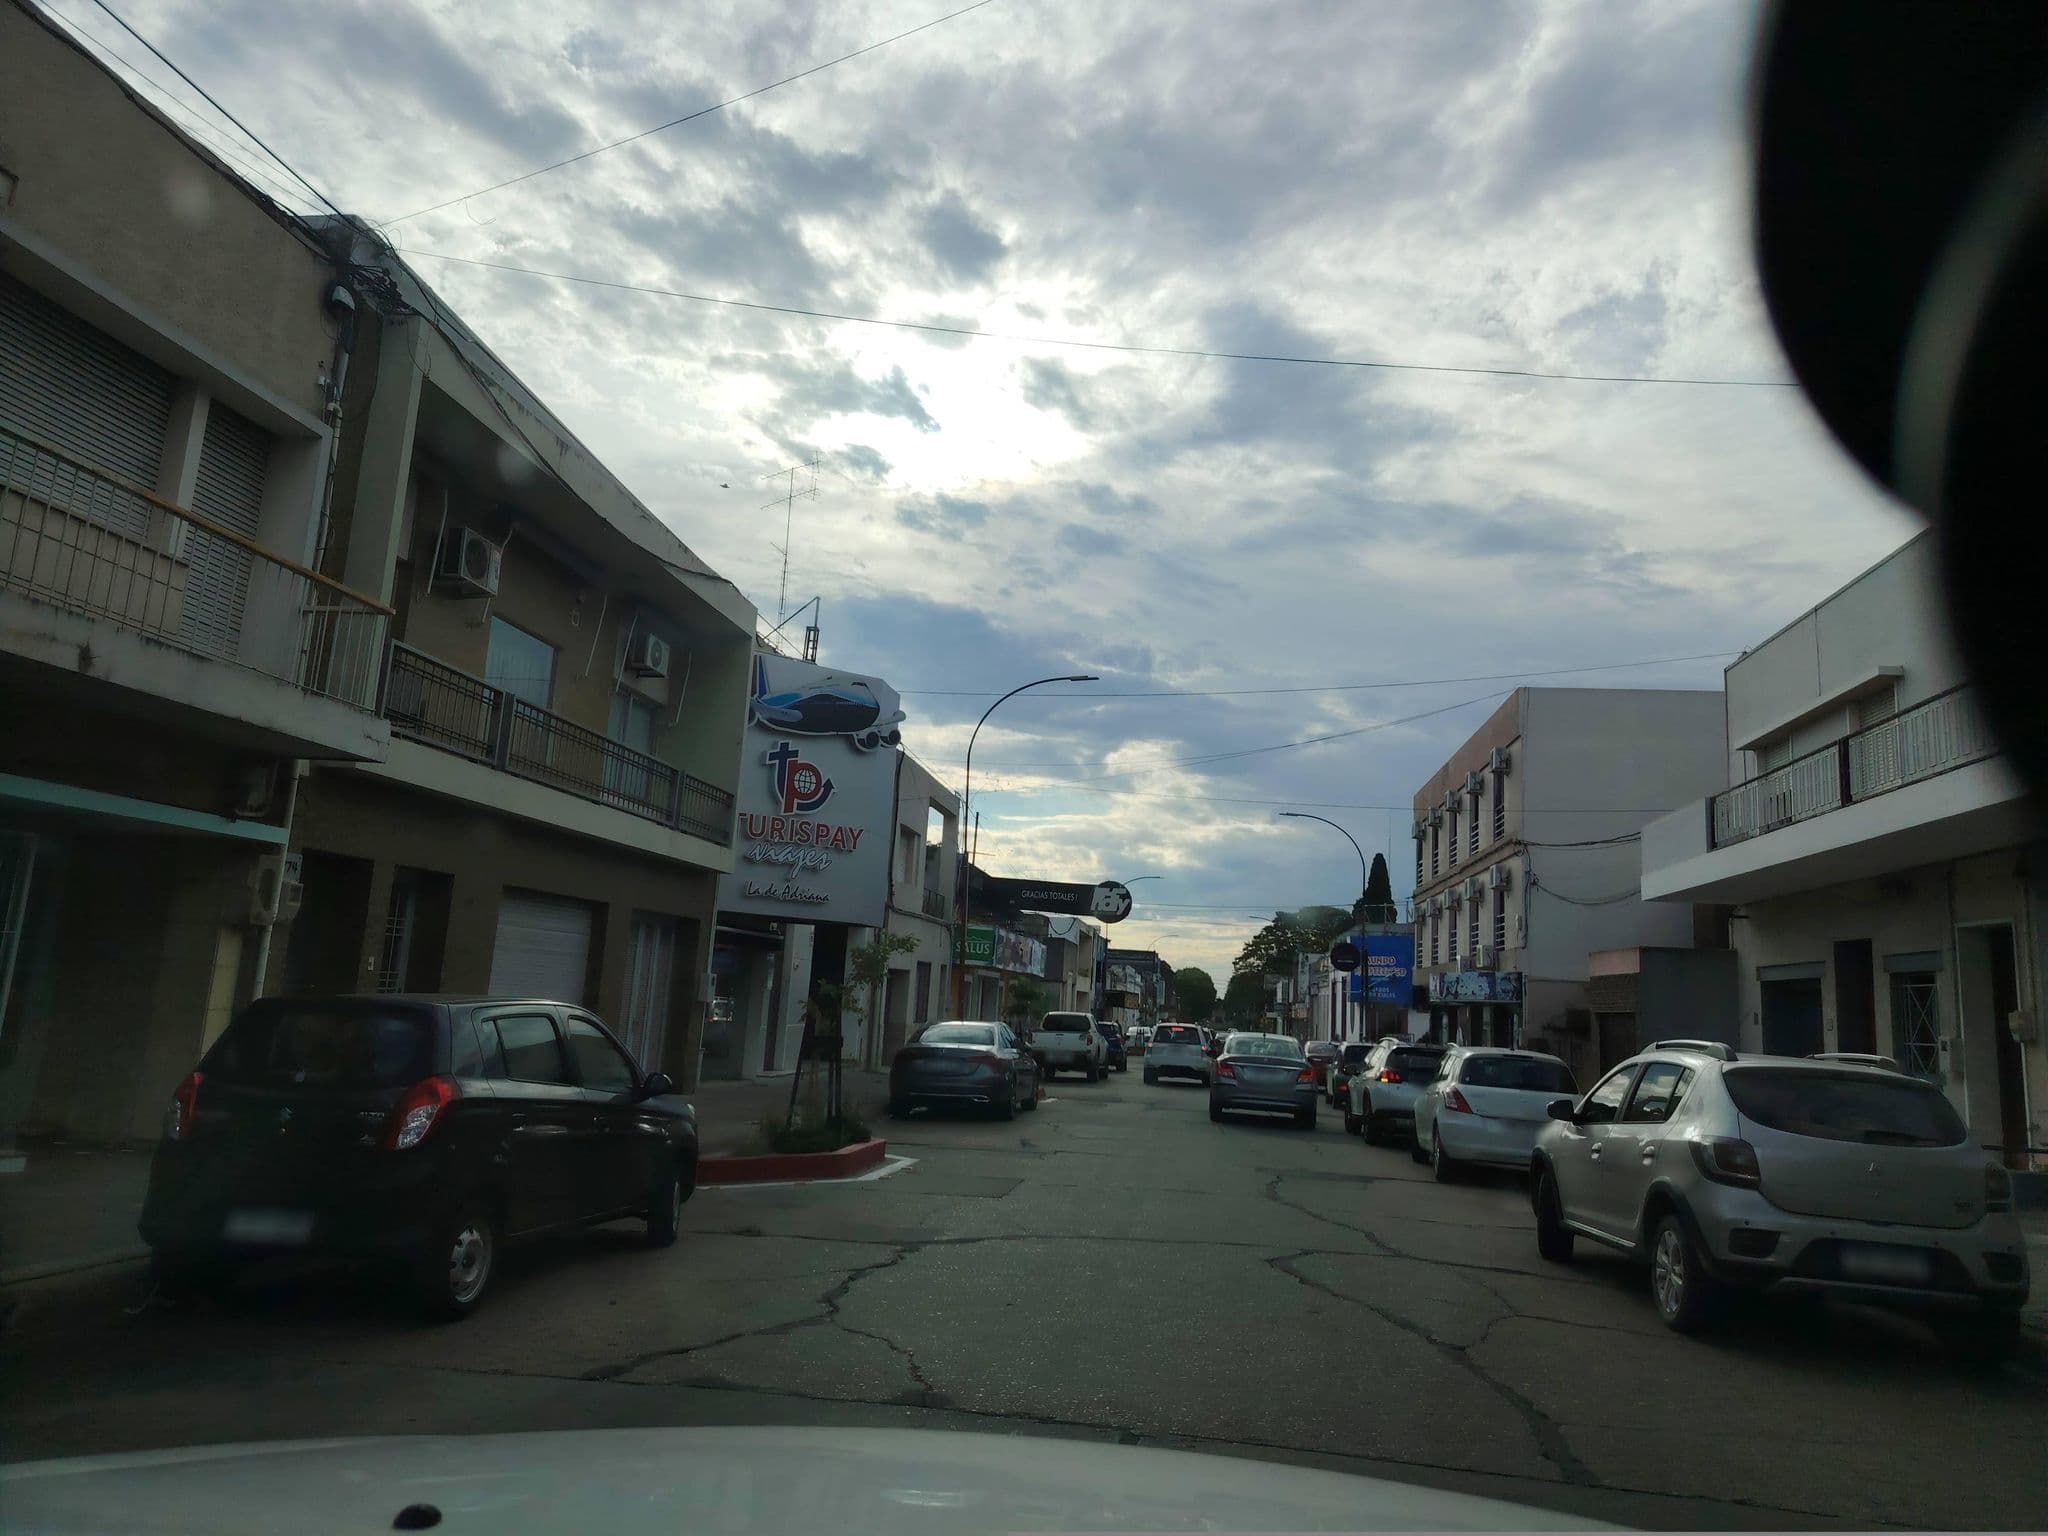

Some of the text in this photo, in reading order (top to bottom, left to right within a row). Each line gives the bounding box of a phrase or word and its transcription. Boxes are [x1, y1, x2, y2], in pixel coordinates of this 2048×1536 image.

[747, 881, 831, 903] La de Adriana
[1021, 889, 1048, 900] GRACIAS
[955, 941, 990, 955] SALUS
